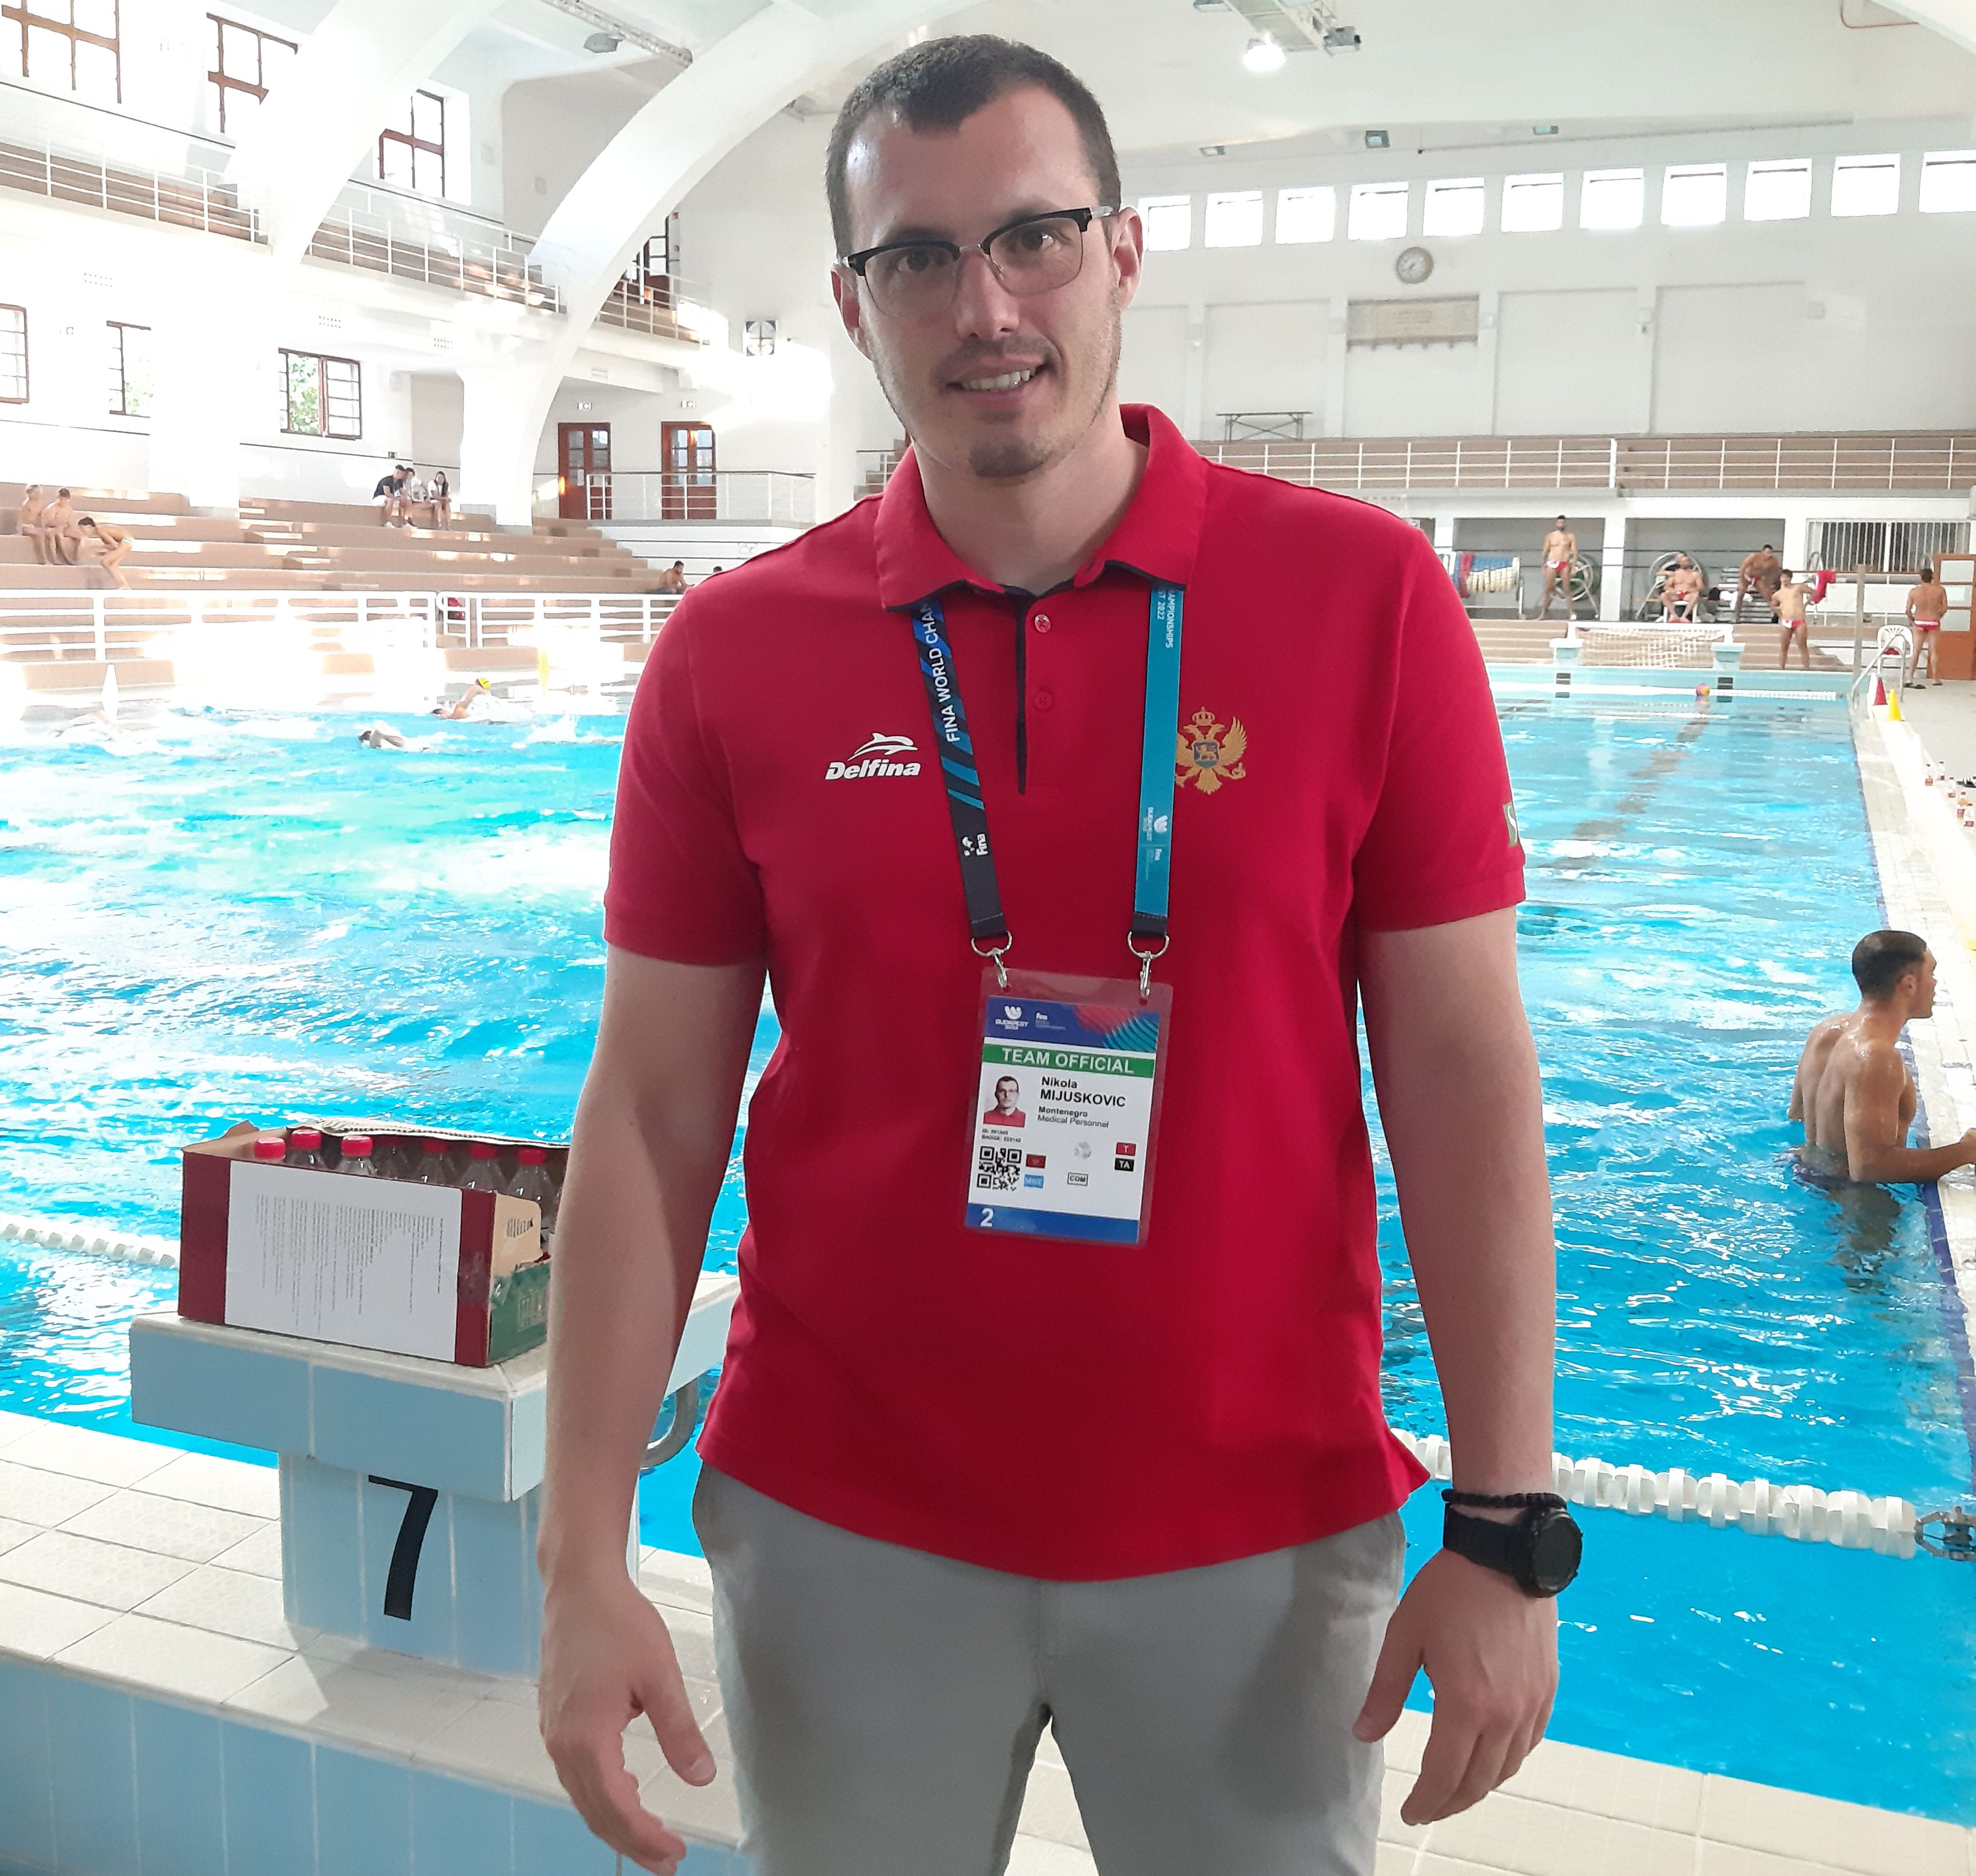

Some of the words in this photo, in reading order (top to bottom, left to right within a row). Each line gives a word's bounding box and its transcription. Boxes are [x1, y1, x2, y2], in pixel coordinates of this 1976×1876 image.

[929, 647, 951, 703] WORLD
[941, 704, 960, 742] FINA
[825, 758, 921, 780] Delfina
[1001, 1047, 1050, 1066] TEAM
[1054, 1053, 1134, 1074] OFFICIAL
[1041, 1076, 1078, 1089] Nikola
[1040, 1088, 1126, 1107] MIJUSKOVIC
[1037, 1114, 1068, 1124] Medical
[1069, 1117, 1109, 1128] Personnel
[1038, 1106, 1088, 1118] Montenegro
[1119, 1160, 1131, 1170] TA
[980, 1208, 994, 1227] 2
[368, 1474, 438, 1621] 7
